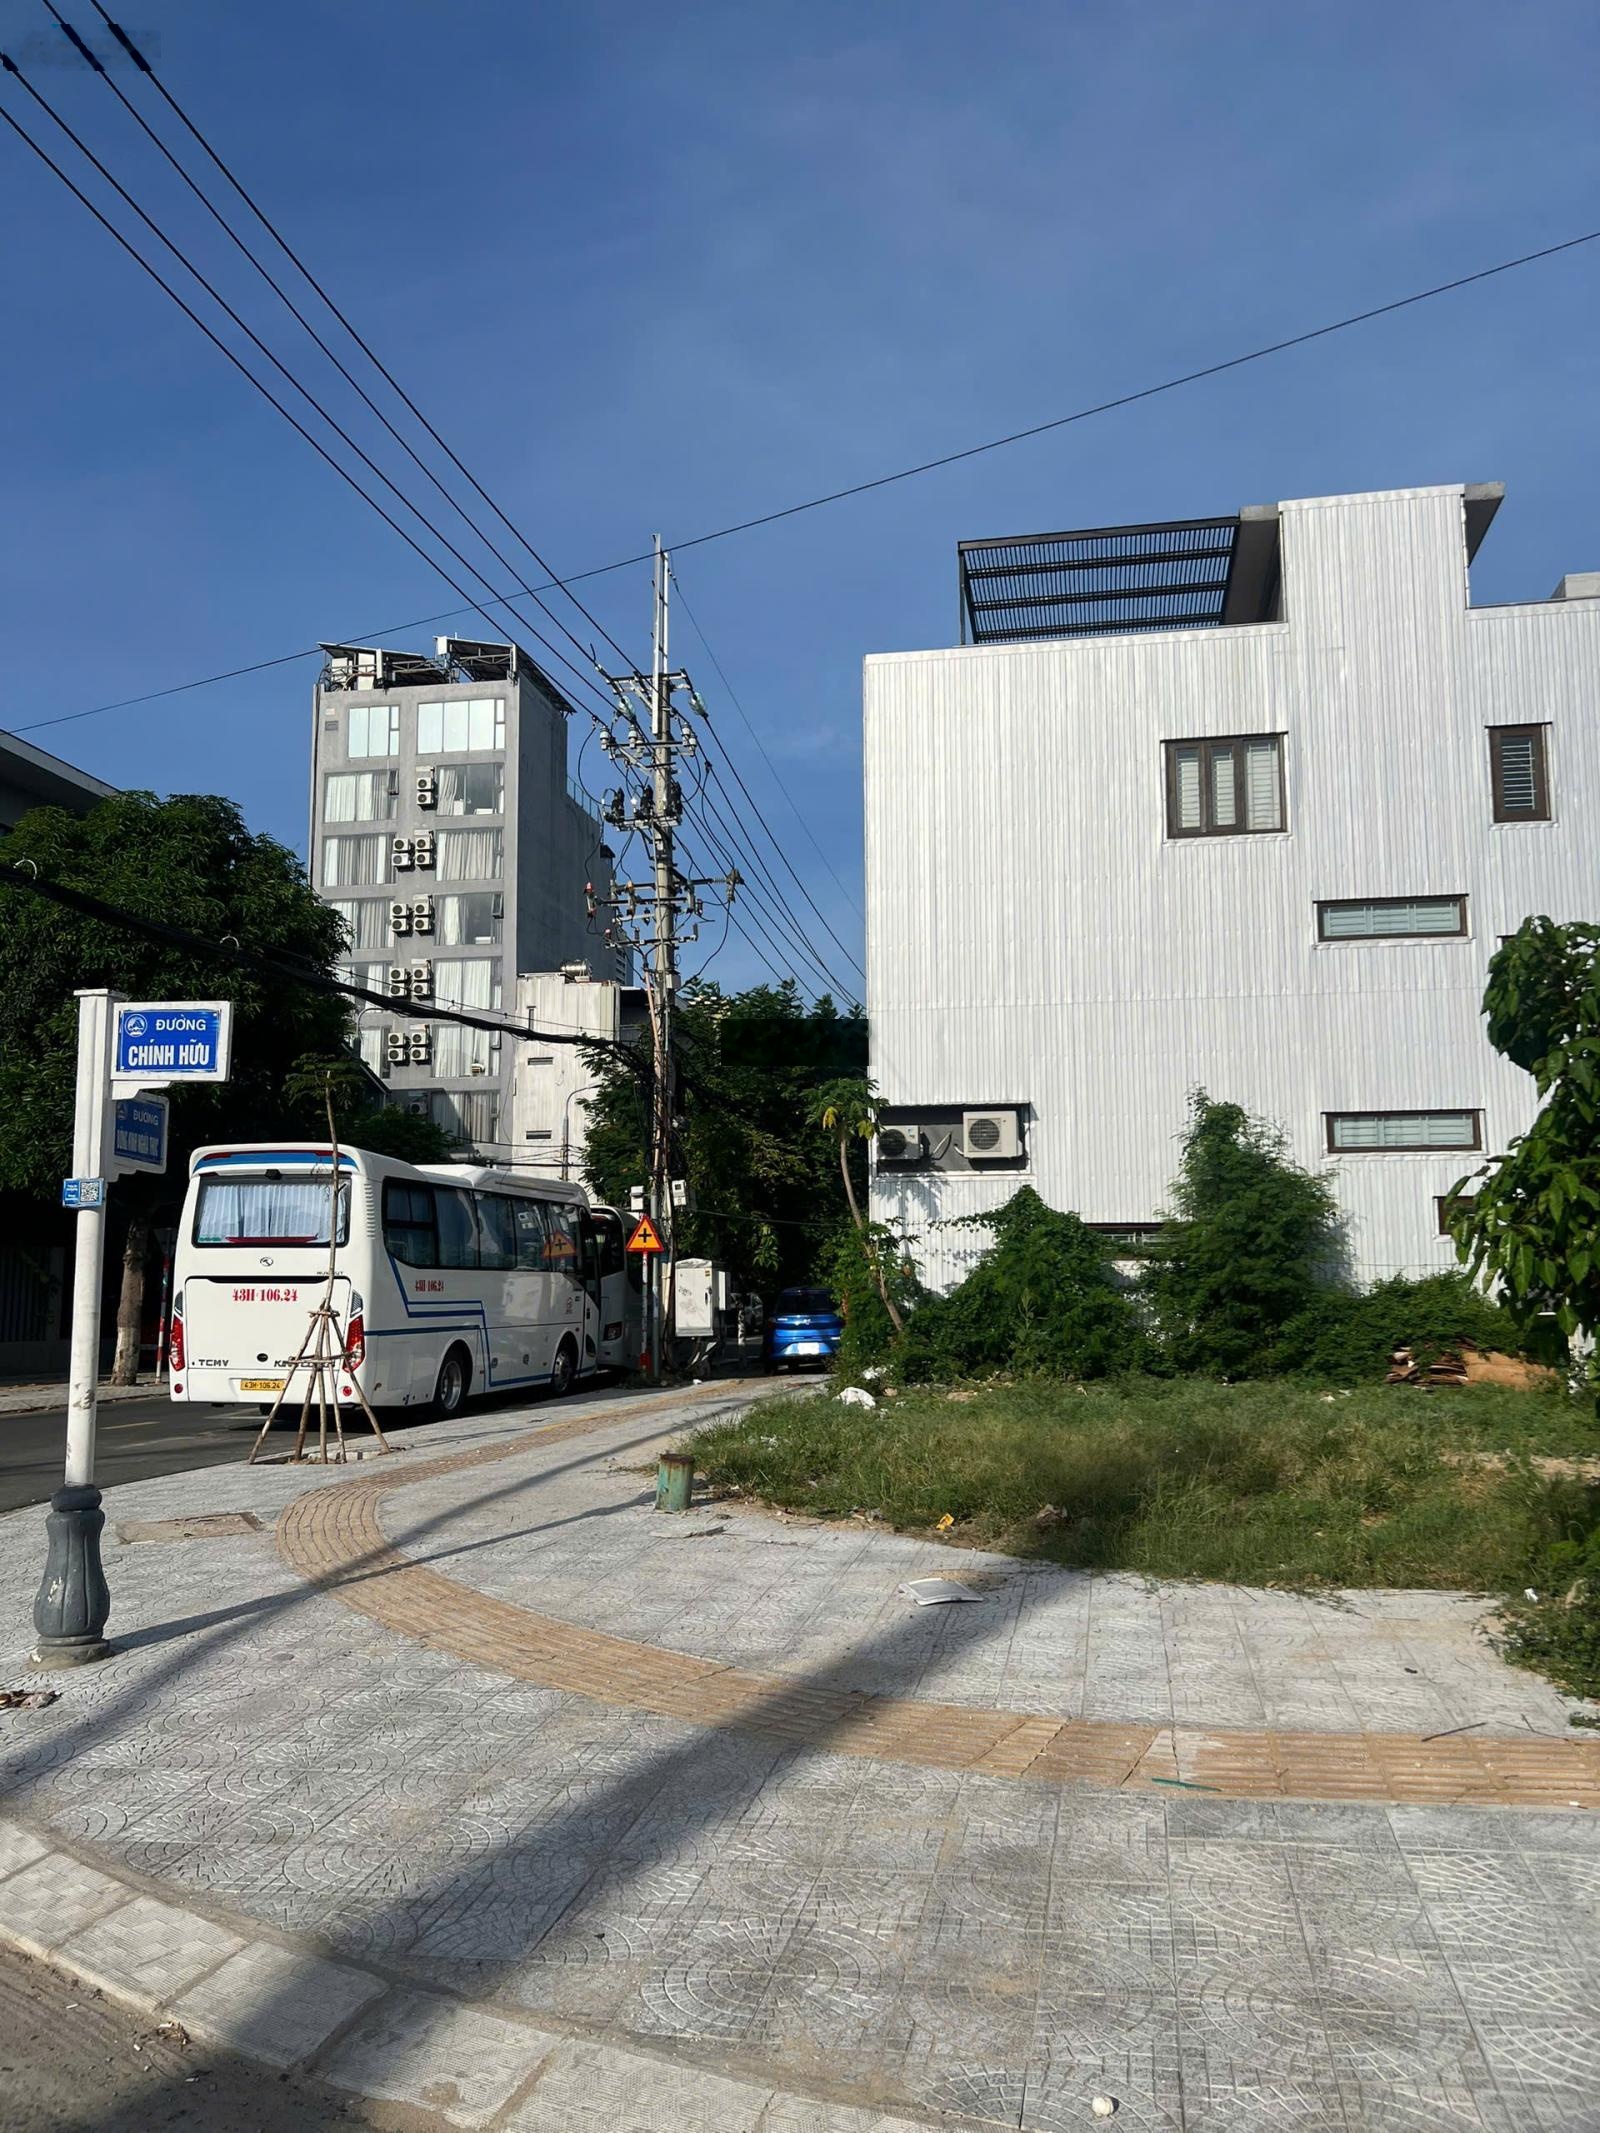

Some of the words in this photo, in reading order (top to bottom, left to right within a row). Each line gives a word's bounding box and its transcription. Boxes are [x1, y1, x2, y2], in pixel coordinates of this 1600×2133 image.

[155, 1014, 206, 1031] ĐƯỜNG
[128, 1039, 175, 1067] CHÍNH
[178, 1039, 210, 1066] HỮU
[198, 1359, 230, 1367] TCMV
